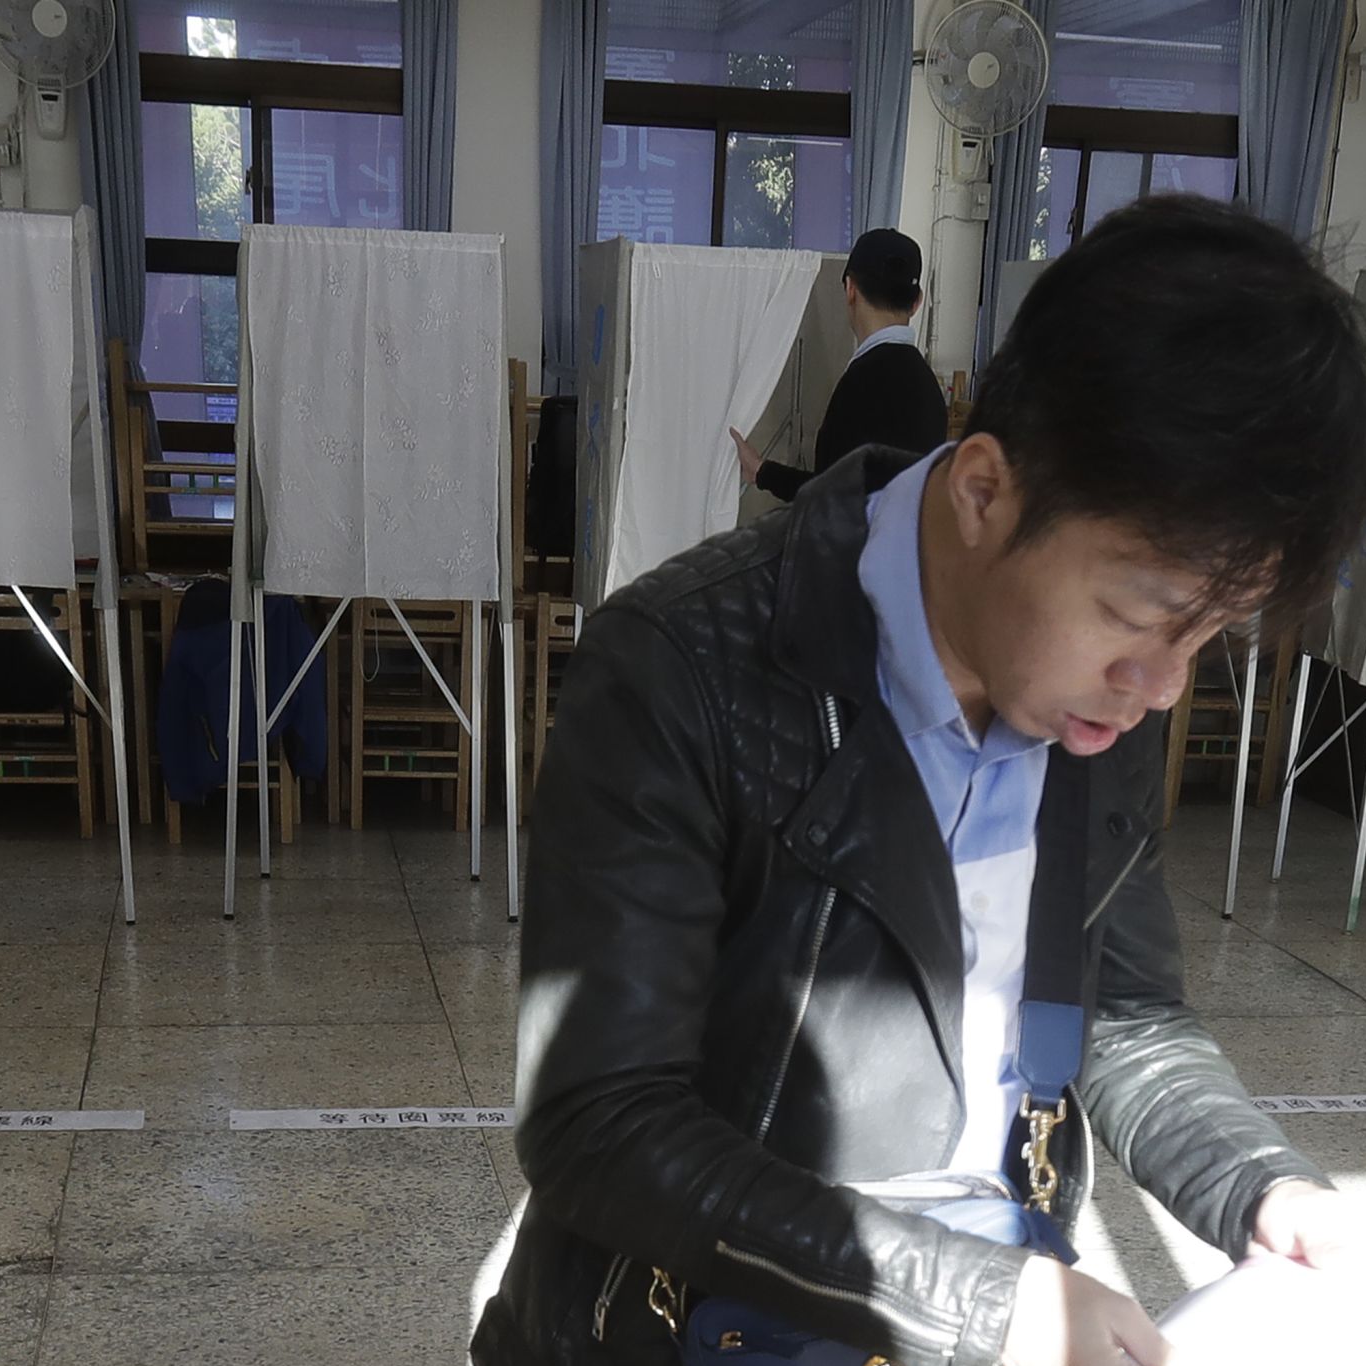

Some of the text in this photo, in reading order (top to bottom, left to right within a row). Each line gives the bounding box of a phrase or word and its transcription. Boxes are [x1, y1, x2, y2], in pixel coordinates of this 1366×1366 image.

[319, 1111, 507, 1124] 等待圈票線
